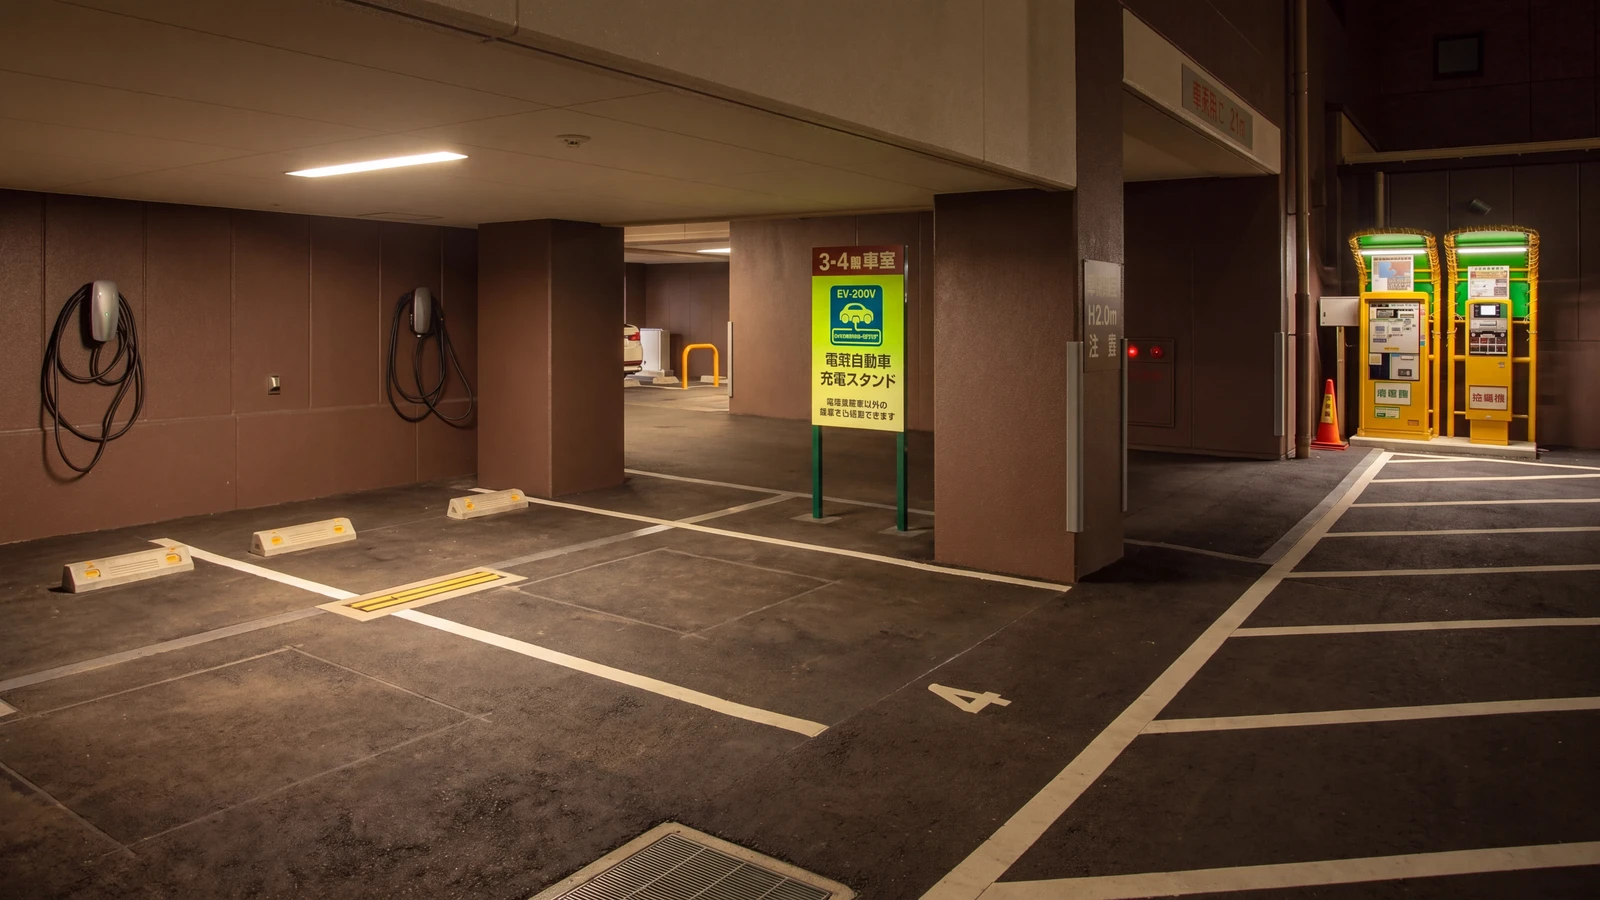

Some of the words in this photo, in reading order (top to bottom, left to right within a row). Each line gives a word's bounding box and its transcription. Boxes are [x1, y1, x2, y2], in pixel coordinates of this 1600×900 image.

[837, 289, 876, 298] EV-200V
[1088, 304, 1117, 326] H2.0m
[820, 371, 896, 389] 充電スタンド
[928, 683, 1012, 714] 4
